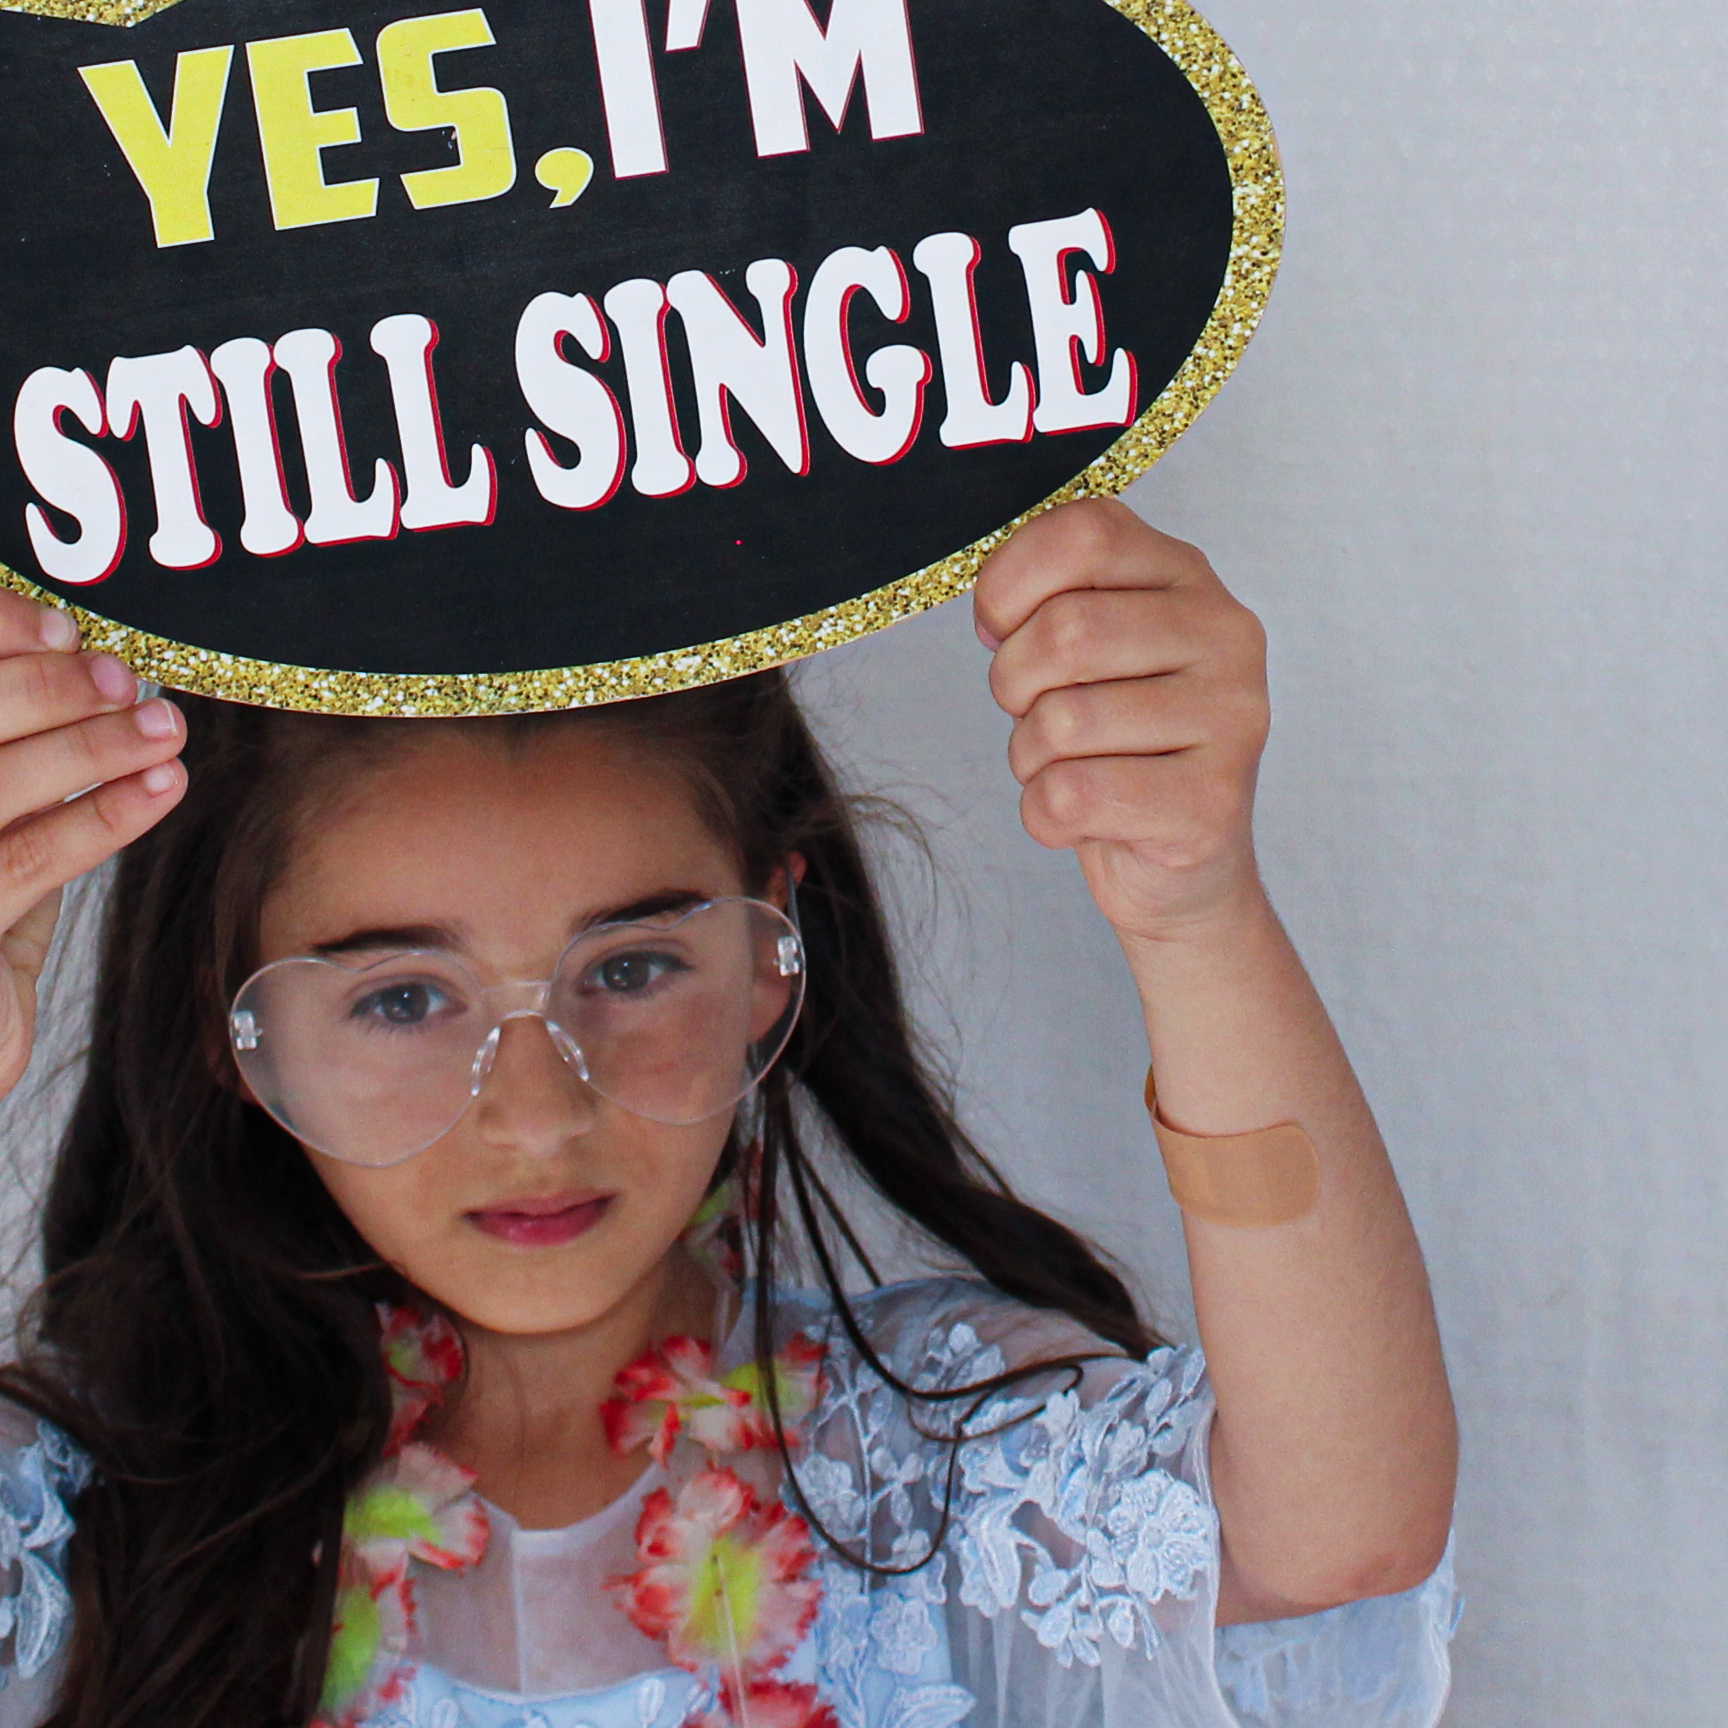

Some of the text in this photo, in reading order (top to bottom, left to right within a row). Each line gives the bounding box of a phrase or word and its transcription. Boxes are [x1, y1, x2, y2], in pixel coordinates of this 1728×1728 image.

[79, 7, 596, 248] YES,
[13, 207, 1139, 586] STILL SINGLE
